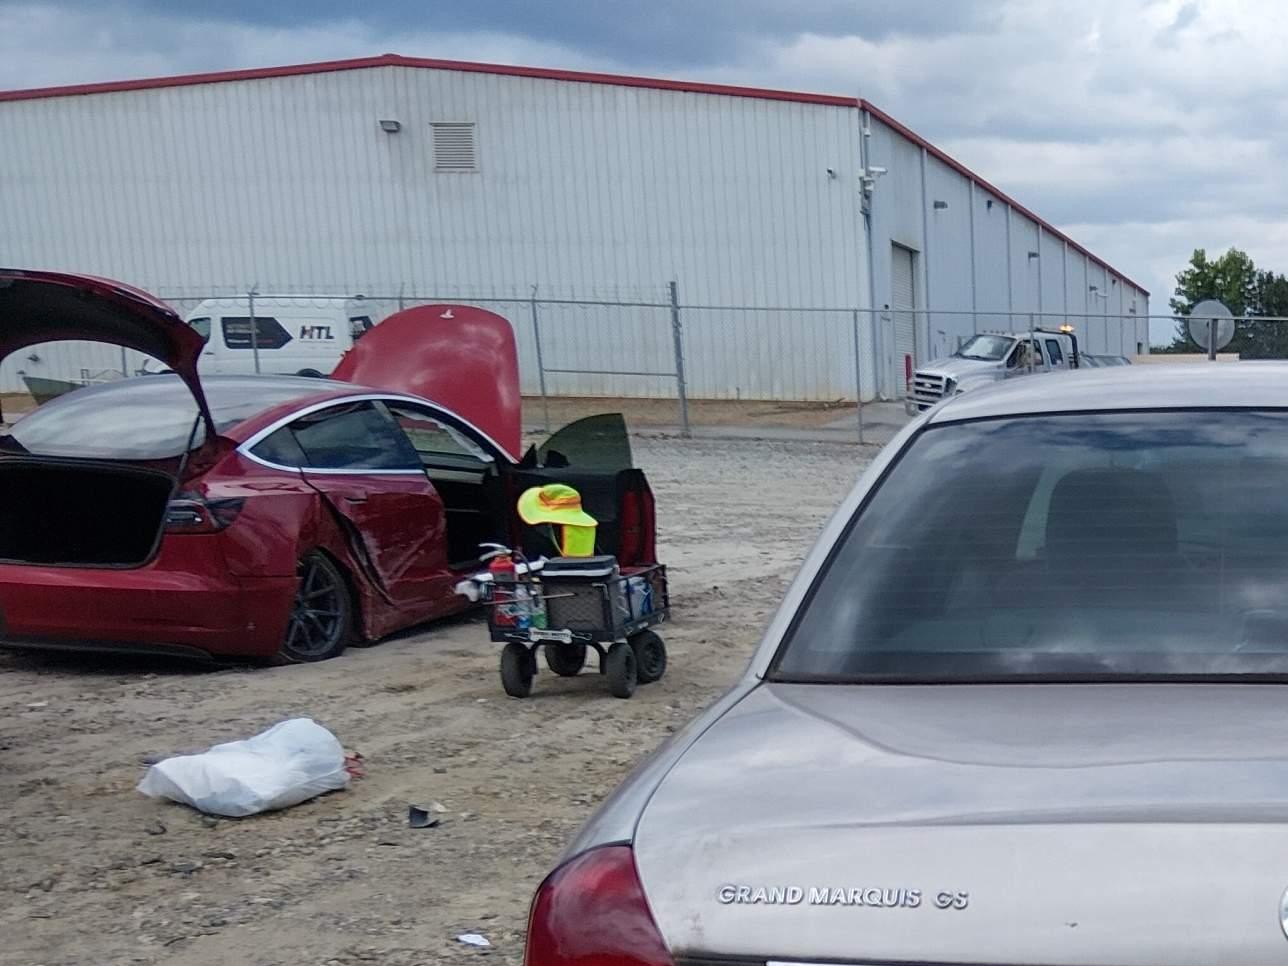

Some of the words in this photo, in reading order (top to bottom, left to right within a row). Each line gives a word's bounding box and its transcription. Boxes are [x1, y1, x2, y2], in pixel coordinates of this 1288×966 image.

[300, 325, 335, 340] HTL
[719, 885, 804, 905] GRAND
[808, 886, 921, 907] MARQUIS
[934, 890, 969, 910] GS
